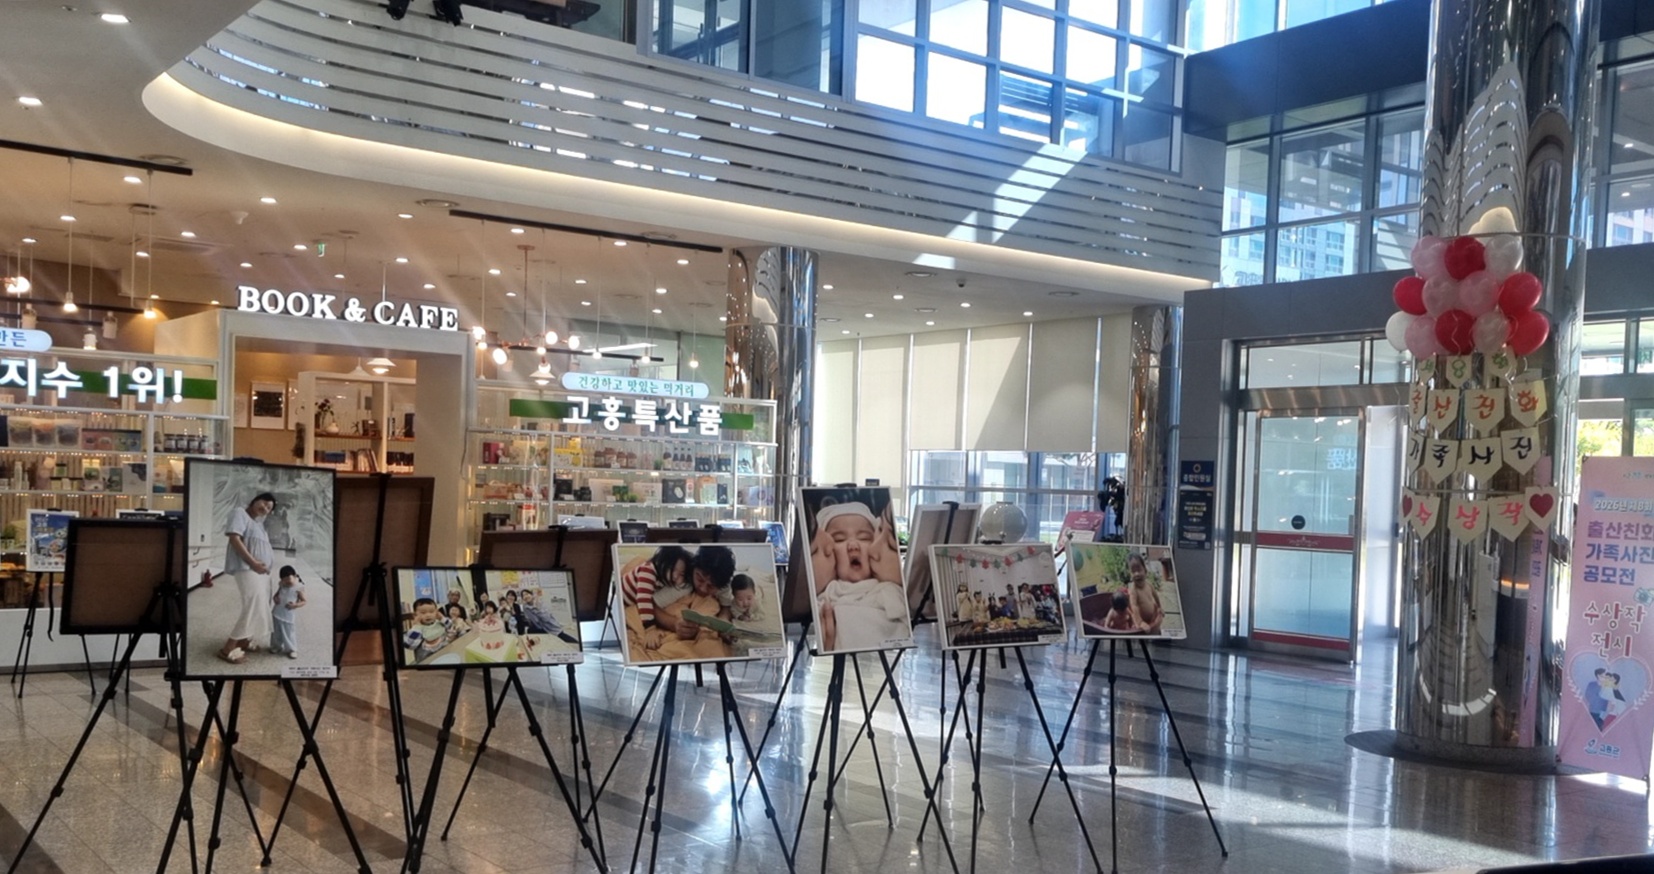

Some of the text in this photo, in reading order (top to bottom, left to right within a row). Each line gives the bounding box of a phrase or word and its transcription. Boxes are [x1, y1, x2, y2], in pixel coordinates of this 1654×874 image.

[237, 285, 459, 331] BOOK & CAFE
[103, 365, 183, 404] 1위!
[578, 376, 695, 396] 건강하고 맛있는 먹거리
[562, 396, 723, 436] 고흥특산품
[1409, 436, 1533, 468] 가족사진
[1416, 502, 1524, 531] 수상작
[1594, 500, 1628, 513] 2026년
[1585, 543, 1654, 564] 가족사진
[1583, 564, 1636, 586] 공모전
[1584, 602, 1646, 633] 수상작
[1592, 632, 1631, 658] 전시
